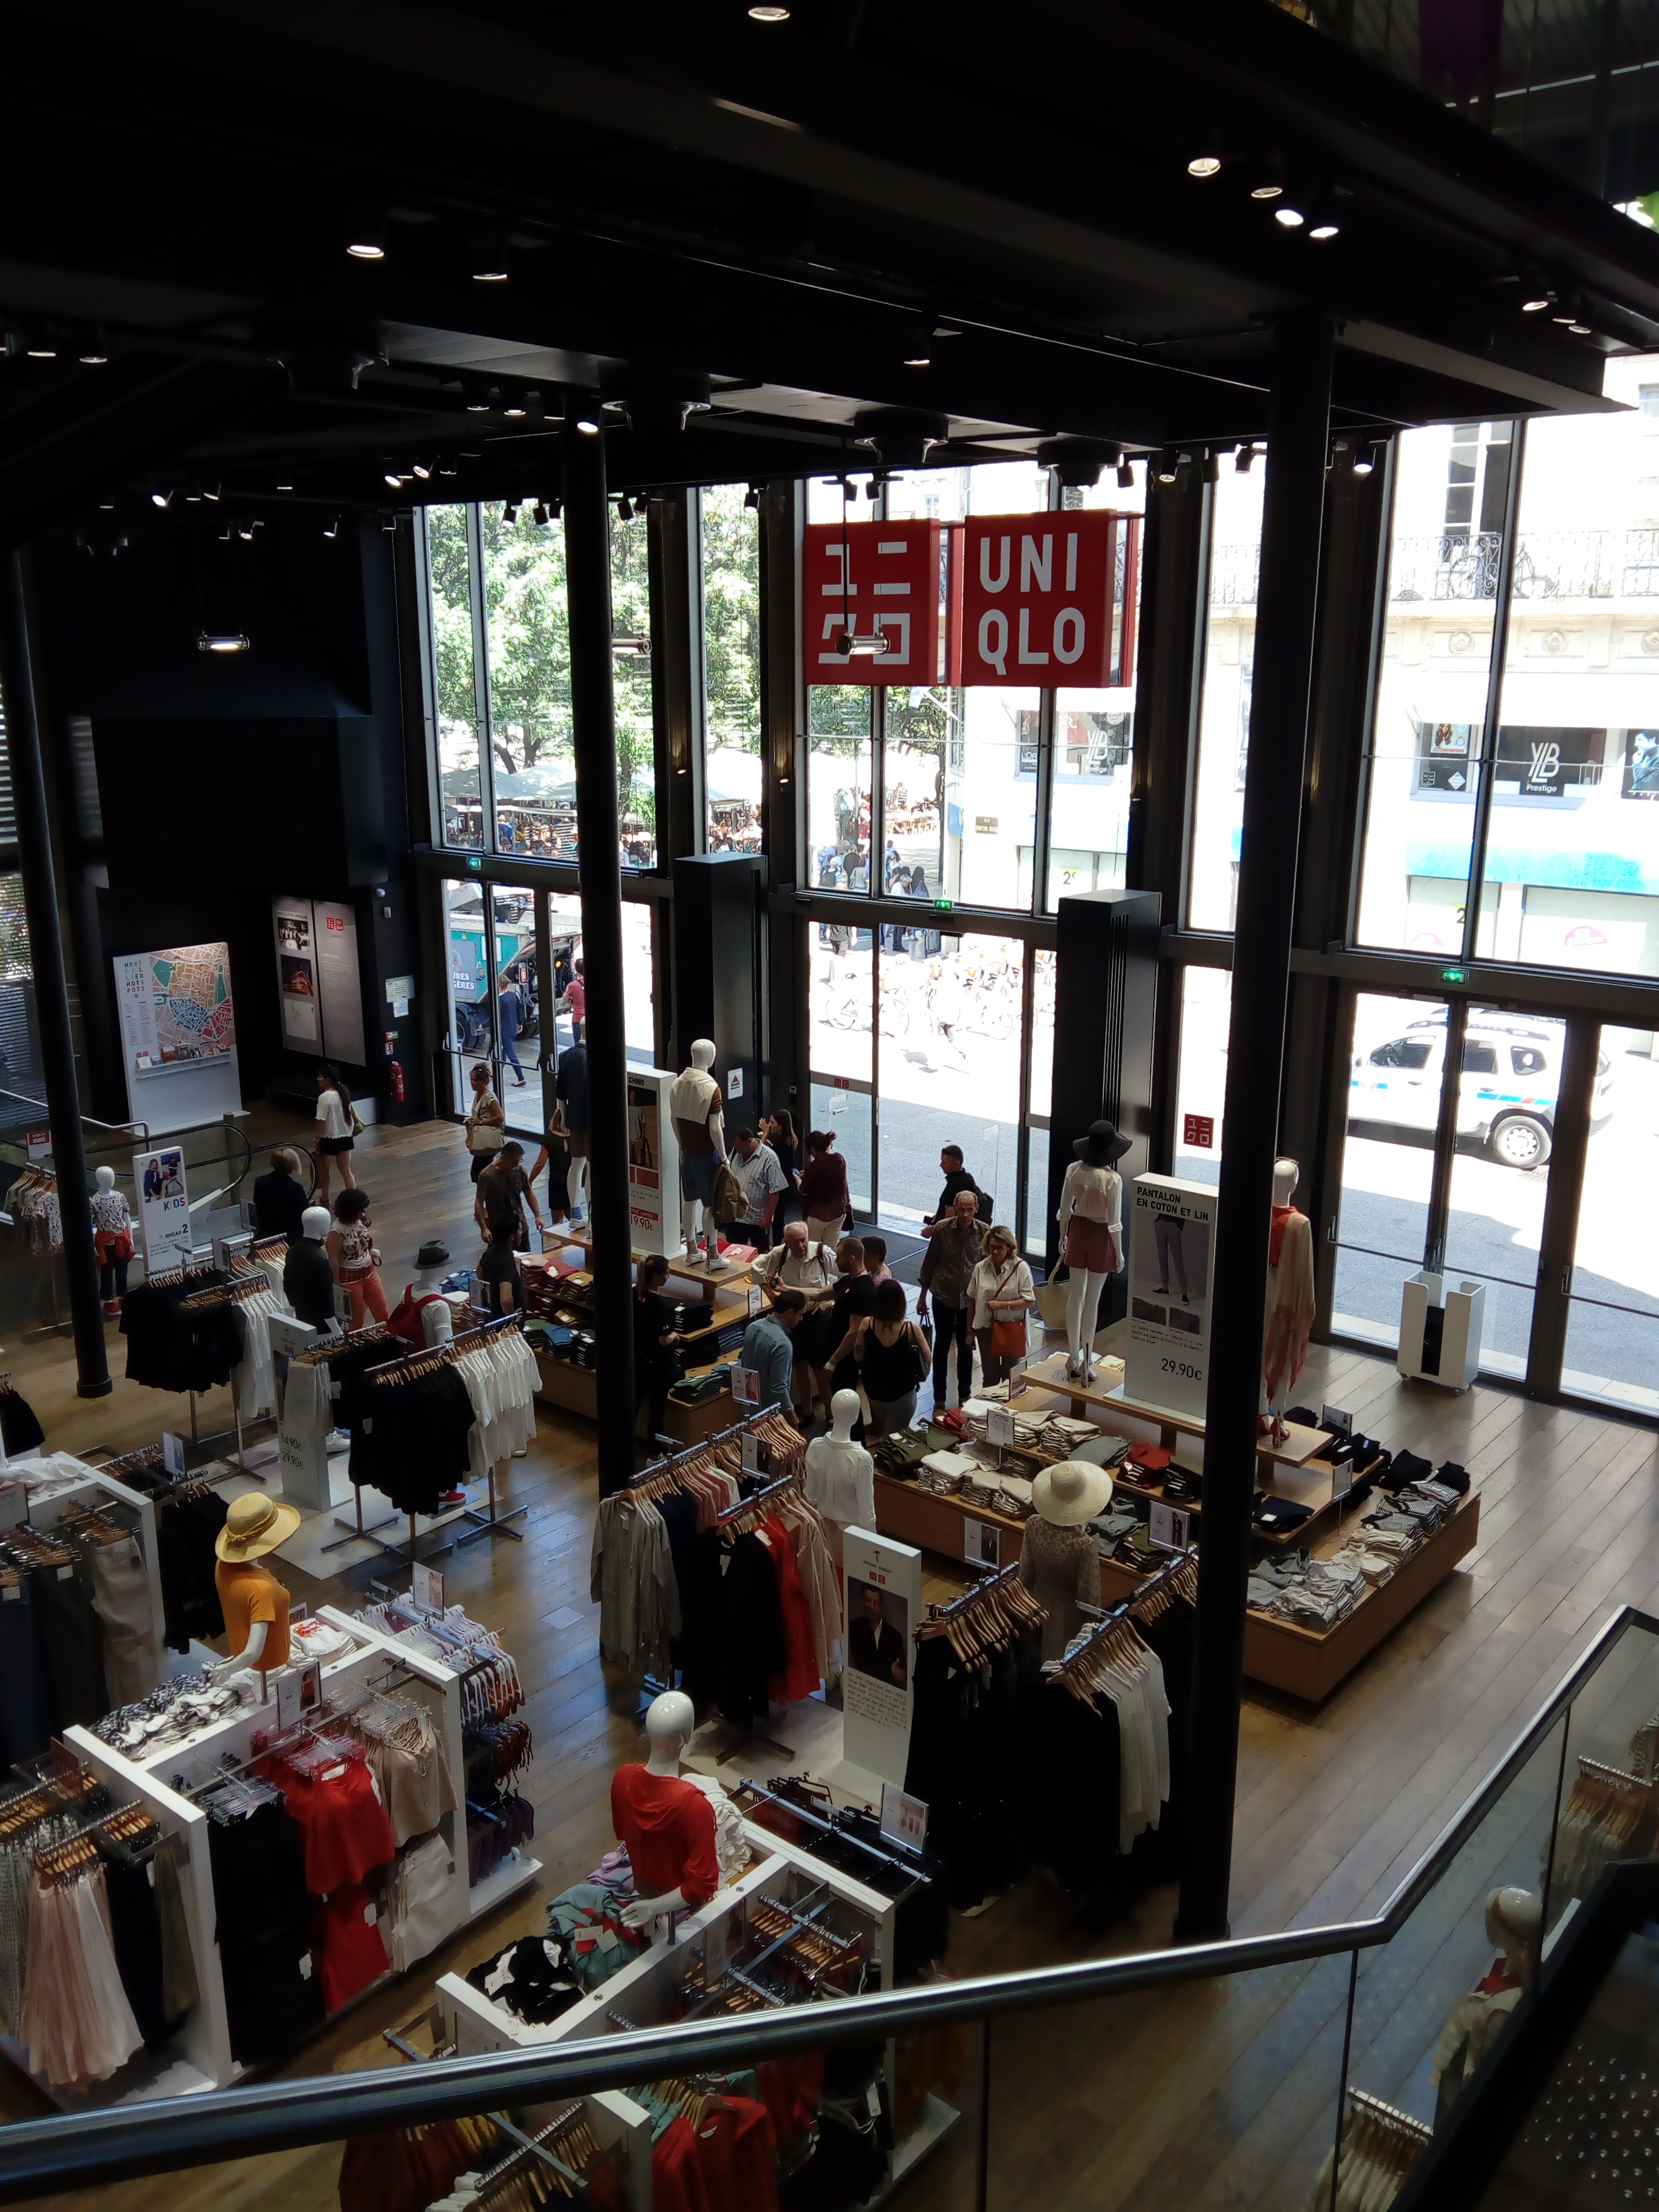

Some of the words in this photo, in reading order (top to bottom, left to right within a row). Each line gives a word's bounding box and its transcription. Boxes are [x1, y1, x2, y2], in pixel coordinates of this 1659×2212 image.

[980, 533, 1078, 593] UNI
[978, 607, 1085, 675] QLO
[1527, 784, 1557, 794] Prestige
[629, 1077, 644, 1086] CHINO
[1137, 1187, 1180, 1203] PANTALON
[164, 1197, 186, 1211] KIDS
[1137, 1198, 1147, 1207] EN
[1151, 1201, 1177, 1214] COTON
[1180, 1207, 1191, 1217] ET
[1195, 1210, 1208, 1220] LIN
[182, 1224, 188, 1234] 2
[1161, 1358, 1202, 1380] 29.90€
